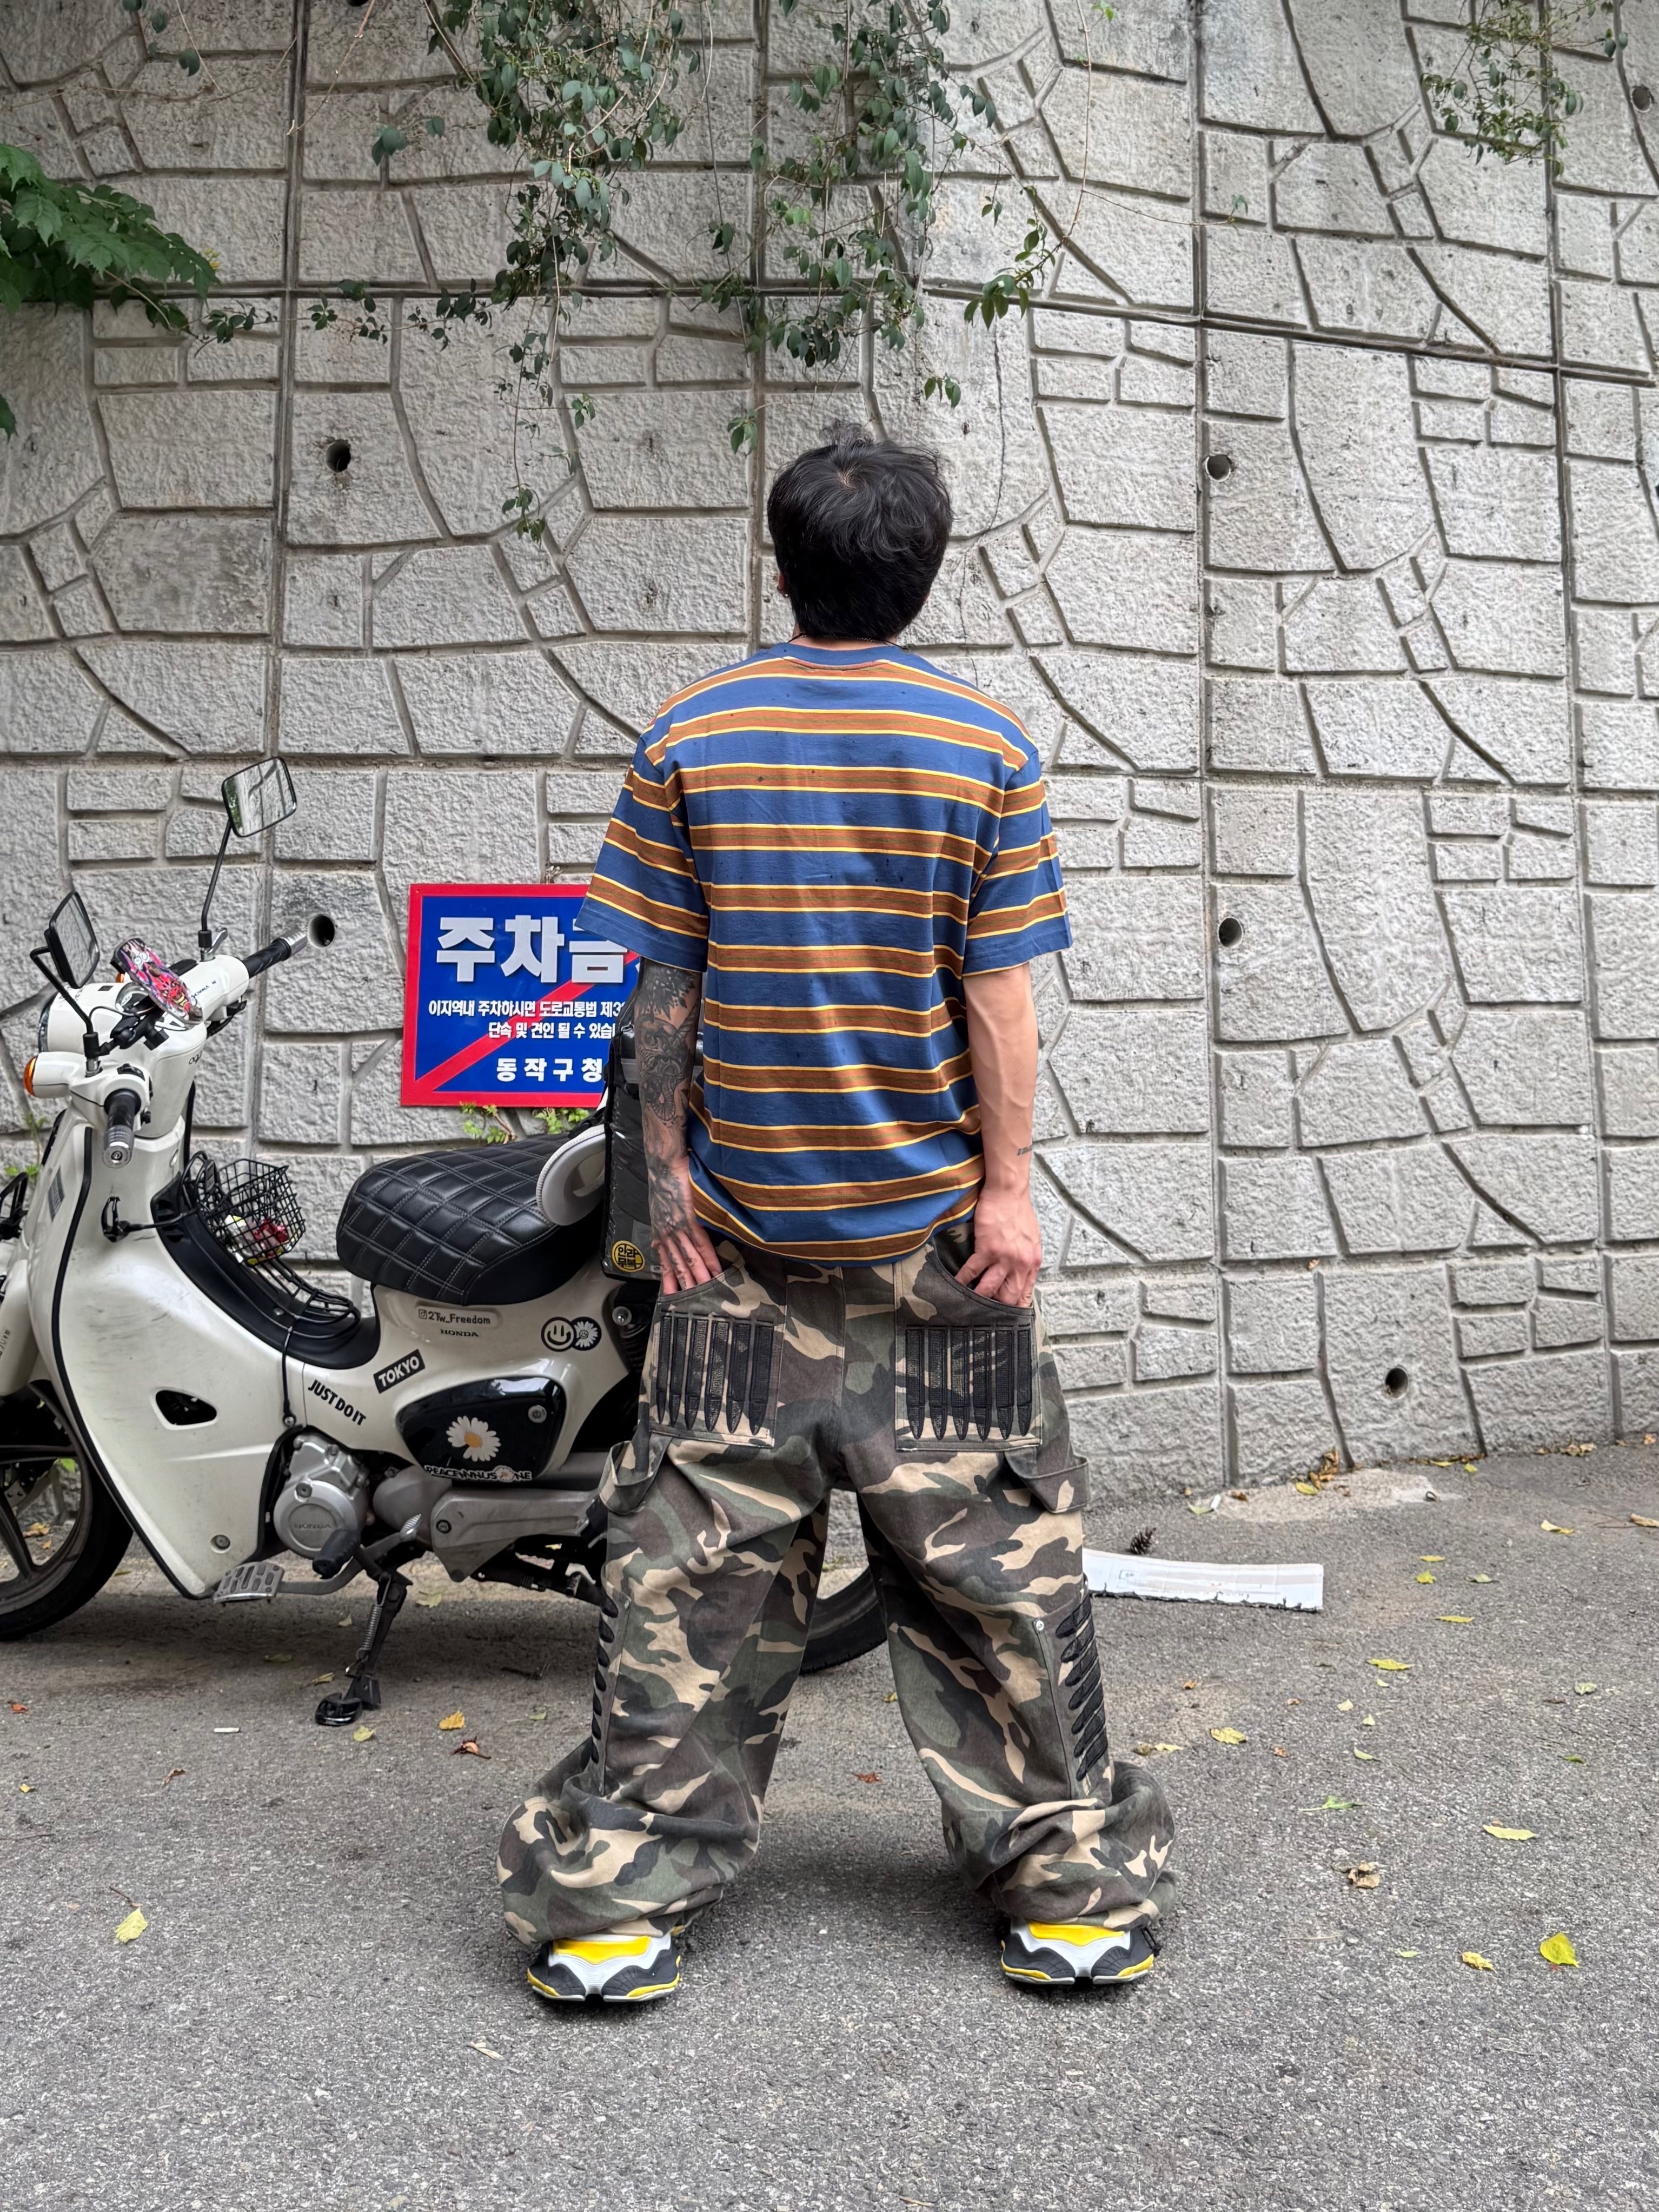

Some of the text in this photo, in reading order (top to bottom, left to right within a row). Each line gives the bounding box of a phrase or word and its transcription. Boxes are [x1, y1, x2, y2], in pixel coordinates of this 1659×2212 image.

[436, 915, 641, 983] 주차금
[428, 1000, 625, 1017] 이지역내 주차하시면 도로교통법 제3
[488, 1022, 512, 1039] 단속
[515, 1022, 528, 1039] 및
[531, 1022, 554, 1039] 견인
[558, 1022, 570, 1039] 될
[573, 1022, 586, 1039] 수
[496, 1058, 602, 1082] 동작구청
[440, 1329, 480, 1337] HONDA
[379, 1356, 420, 1387] TOKYO
[308, 1379, 367, 1426] JUST DO IT
